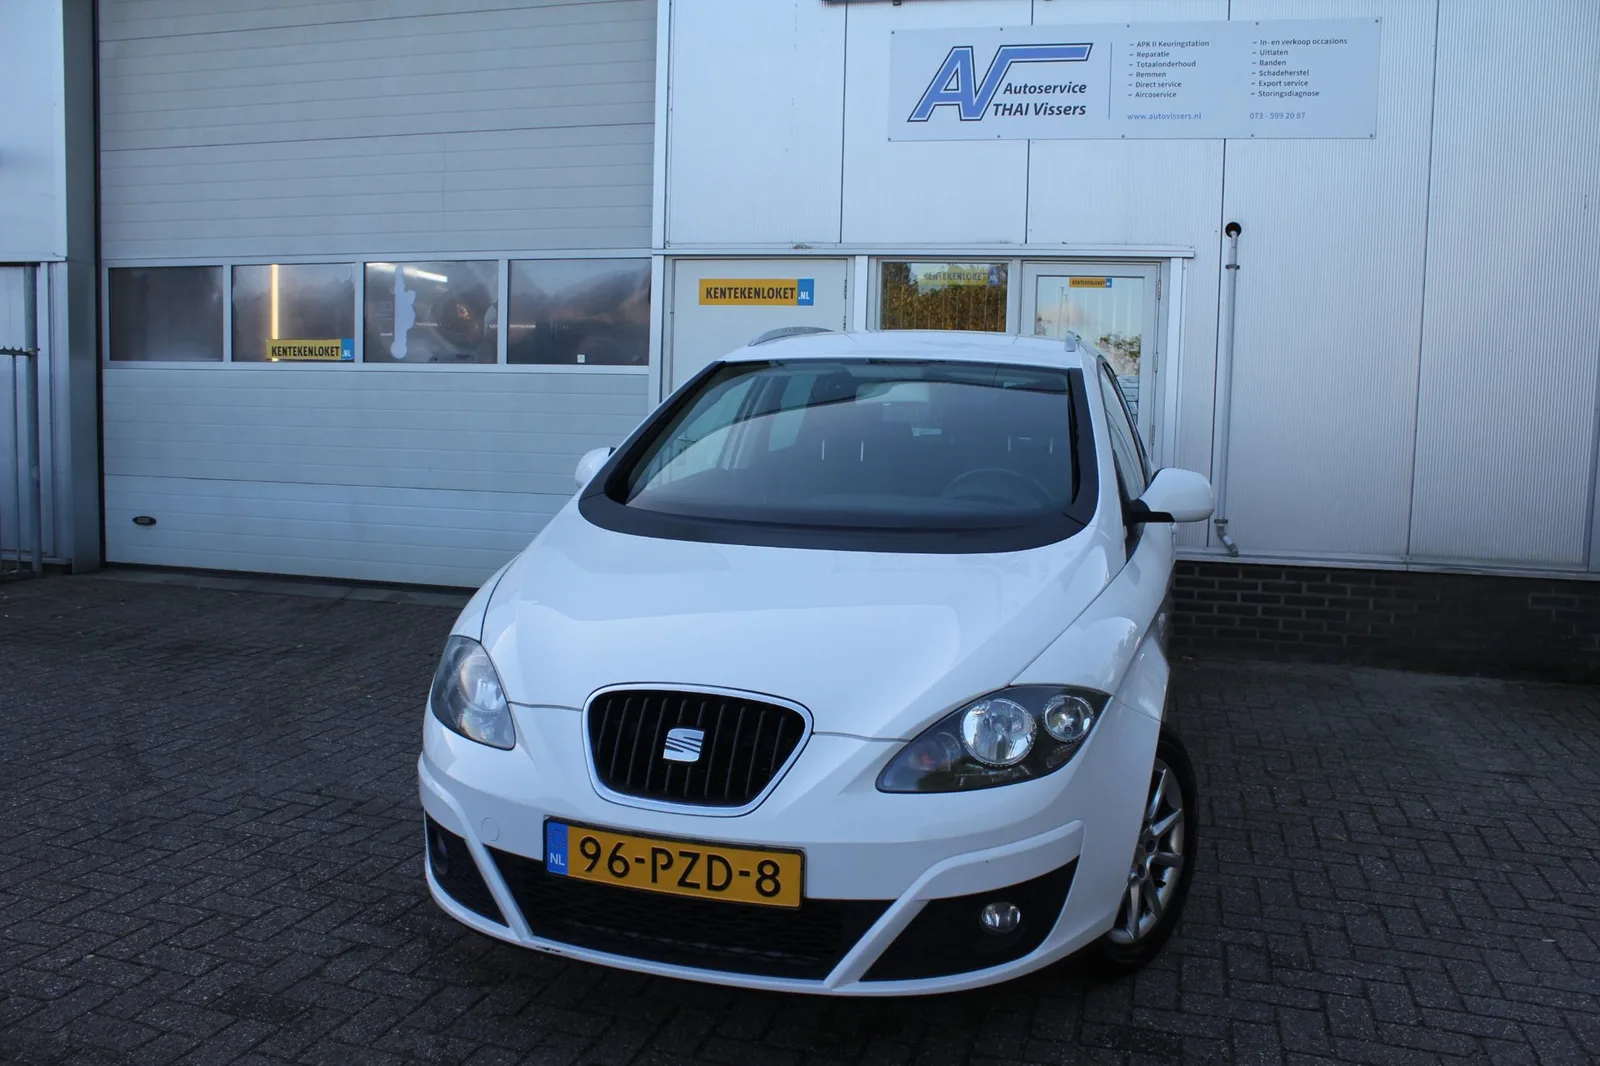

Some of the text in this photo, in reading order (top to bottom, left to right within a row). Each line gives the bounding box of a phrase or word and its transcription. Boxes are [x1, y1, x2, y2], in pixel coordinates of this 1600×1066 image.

[1158, 40, 1209, 48] Keuringstation
[1136, 60, 1196, 68] Totaalonderhoud
[1259, 69, 1310, 77] Schadeherstel
[1003, 81, 1087, 94] Autoservice
[1258, 90, 1320, 98] Storingsdiagnose
[993, 102, 1086, 116] THAI Vissers
[1127, 112, 1202, 120] www.autovissers.nl
[1249, 112, 1264, 120] 073
[1270, 112, 1284, 120] 599
[550, 852, 565, 866] NL
[579, 835, 781, 898] 96-PZD-8
